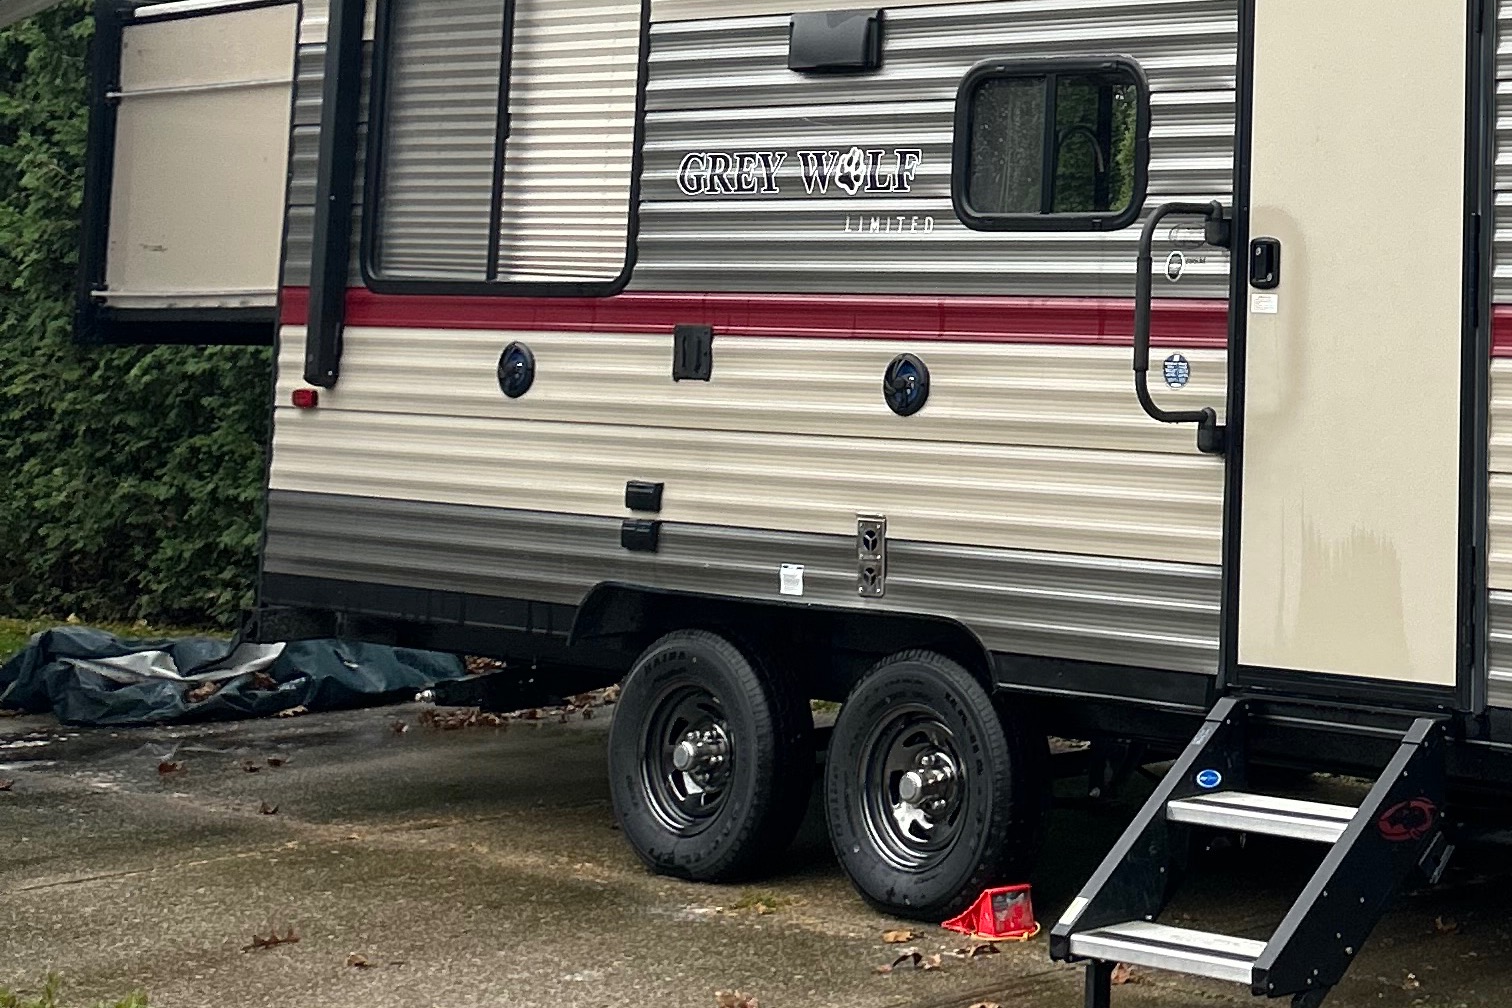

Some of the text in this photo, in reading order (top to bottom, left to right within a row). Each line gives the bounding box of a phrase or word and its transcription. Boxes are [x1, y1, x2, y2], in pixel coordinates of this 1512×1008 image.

[677, 147, 921, 195] GREY WOLF
[844, 216, 934, 234] LIMITED
